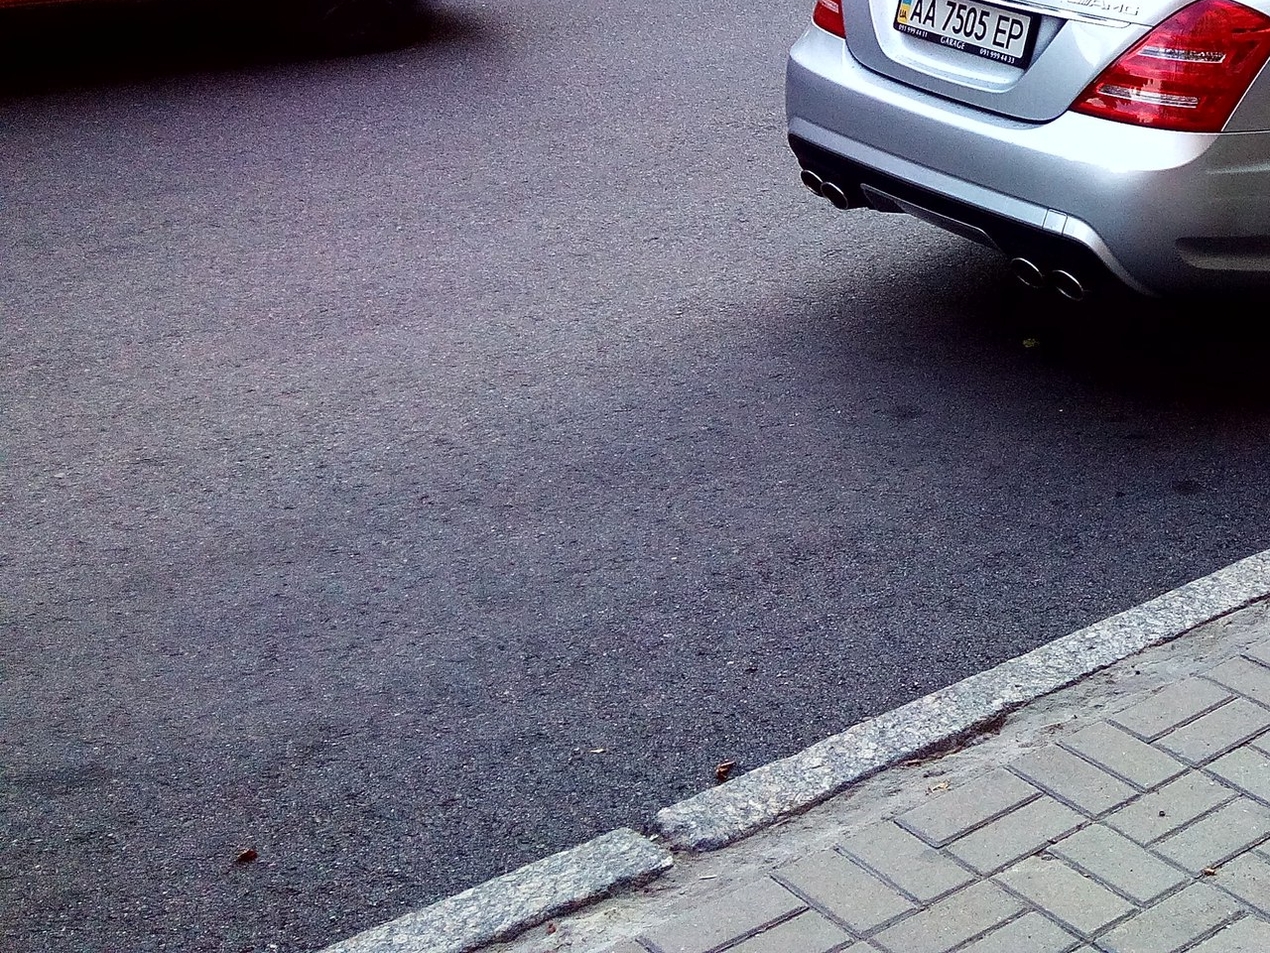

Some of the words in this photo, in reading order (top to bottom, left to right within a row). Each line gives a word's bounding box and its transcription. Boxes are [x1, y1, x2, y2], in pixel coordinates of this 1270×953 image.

[941, 0, 990, 41] 7505
[992, 14, 1024, 50] EP
[940, 36, 966, 50] GARAGE
